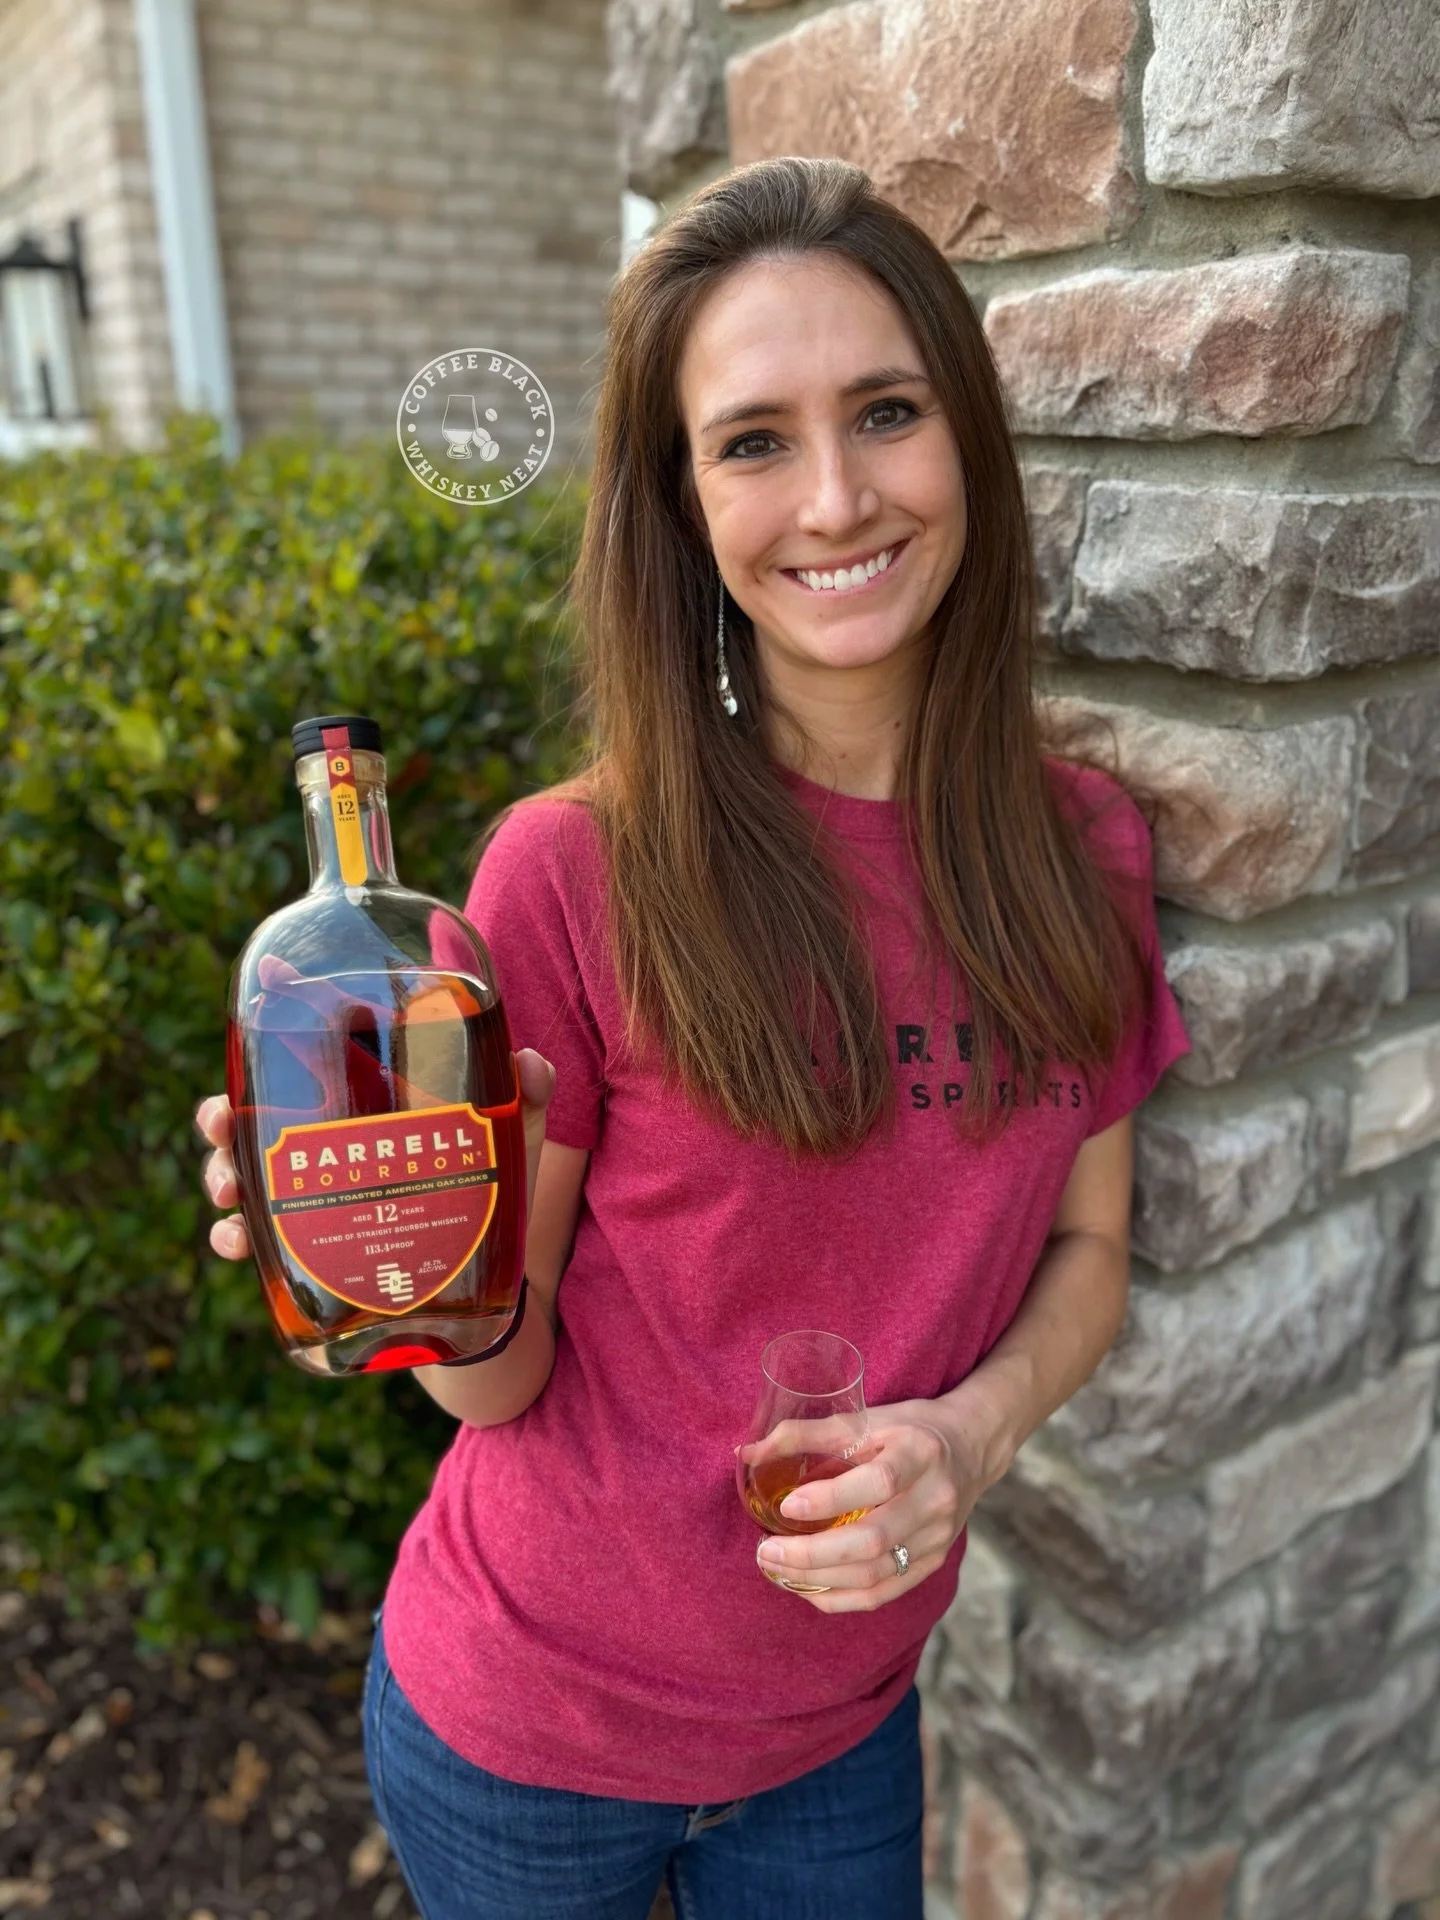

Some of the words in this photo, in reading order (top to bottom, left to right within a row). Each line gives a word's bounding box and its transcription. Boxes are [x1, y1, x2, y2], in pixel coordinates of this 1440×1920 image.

[335, 761, 345, 771] B
[337, 800, 356, 816] 12
[290, 1128, 473, 1171] BARRELL
[293, 1152, 475, 1190] BOURBON
[282, 1198, 325, 1210] FINISHED
[326, 1196, 337, 1204] IN
[339, 1190, 383, 1201] TOASTED
[385, 1183, 434, 1196] AMERICAN
[436, 1179, 456, 1188] OAK
[457, 1174, 489, 1184] CASKS
[353, 1214, 372, 1223] AGED
[374, 1203, 399, 1224] 12
[400, 1206, 425, 1215] YEARS
[319, 1235, 343, 1245] BLEND
[356, 1228, 392, 1239] STRAIGHT
[394, 1222, 430, 1233] BOURBON
[431, 1216, 468, 1227] WHISKEYS
[364, 1242, 390, 1255] 113.4
[390, 1240, 415, 1250] PROOF
